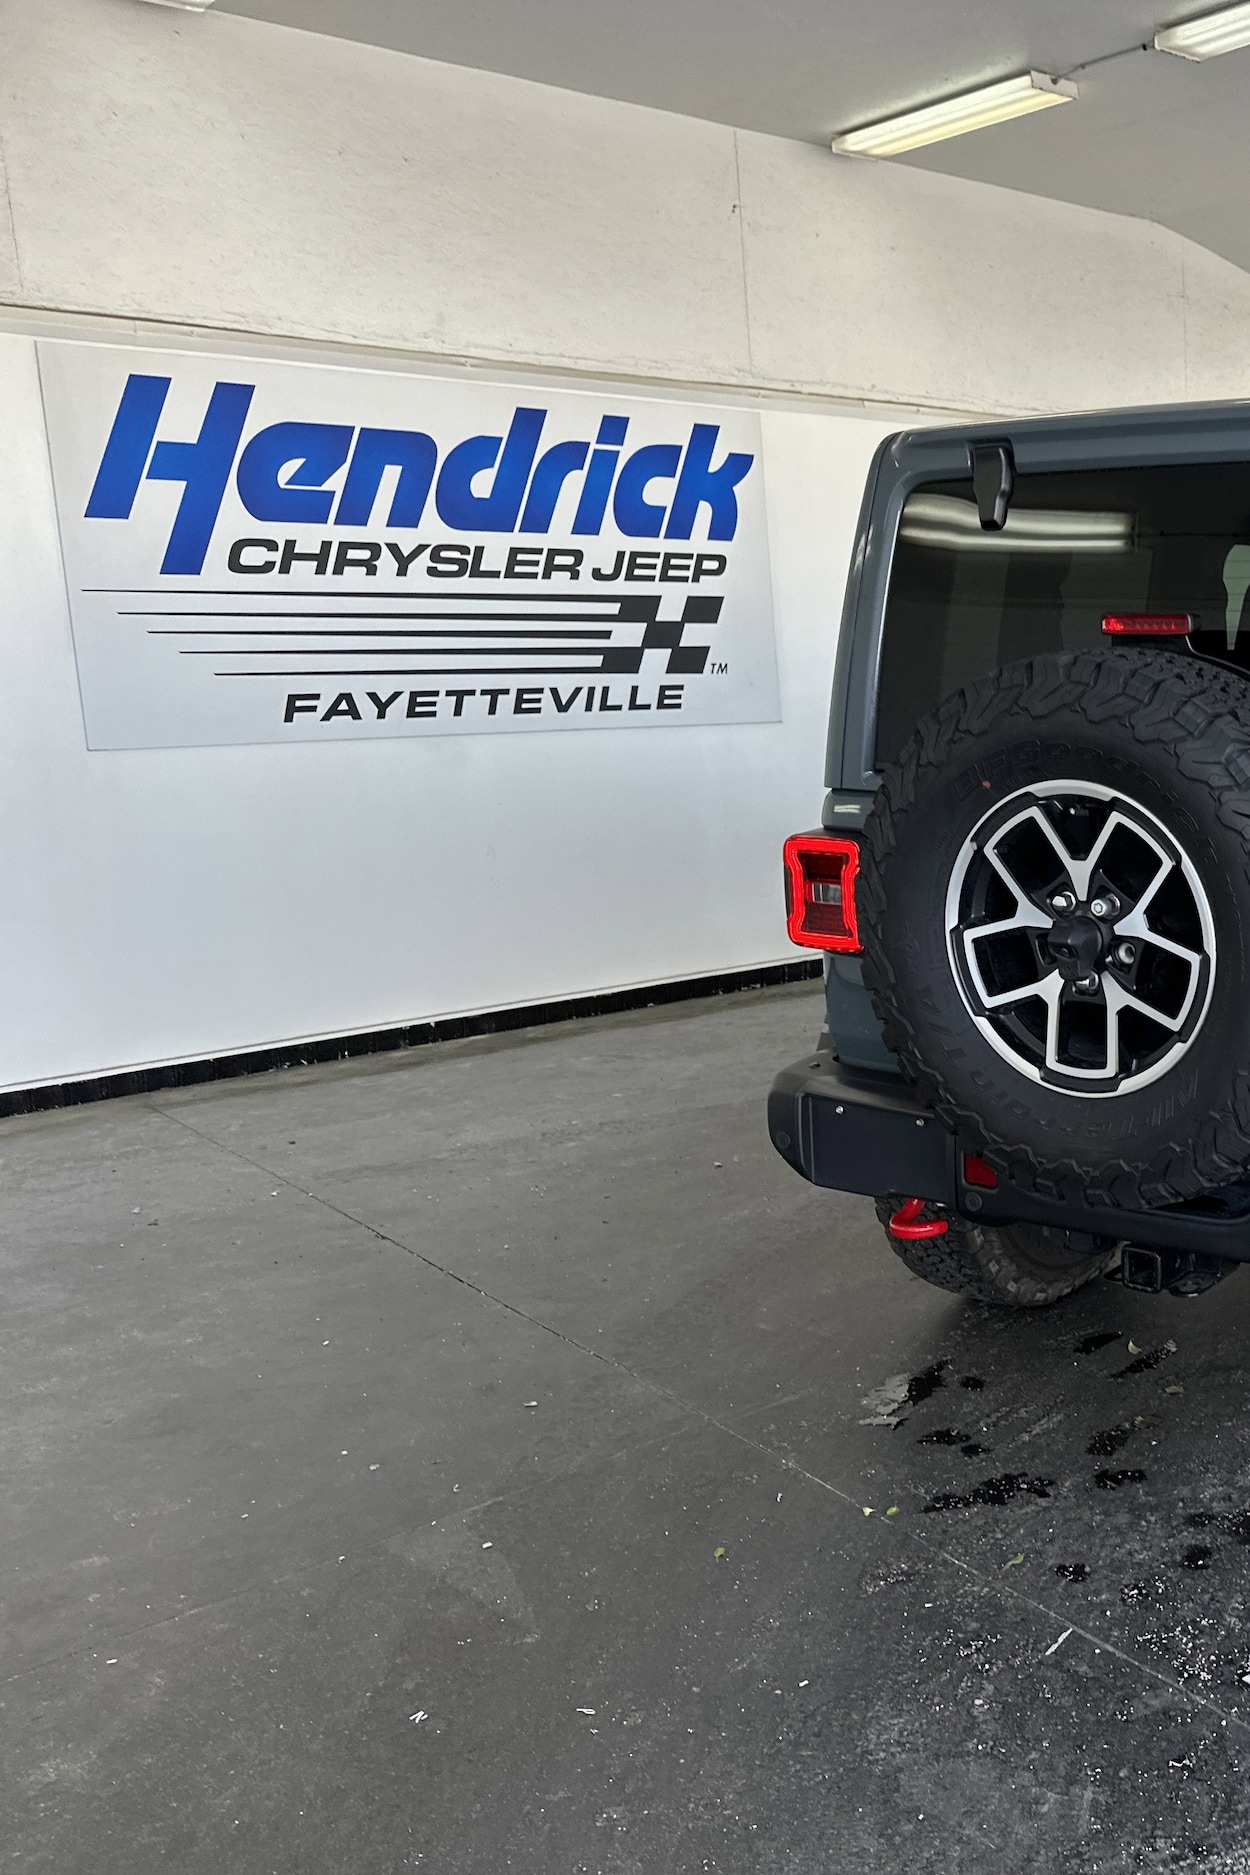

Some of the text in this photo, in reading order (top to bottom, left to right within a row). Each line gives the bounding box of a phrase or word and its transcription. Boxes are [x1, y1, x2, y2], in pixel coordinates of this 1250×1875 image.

[84, 374, 755, 576] Hendrick
[227, 538, 727, 583] CHRYSLER JEEP
[710, 662, 728, 675] TM
[283, 684, 685, 723] FAYETTEVILLE
